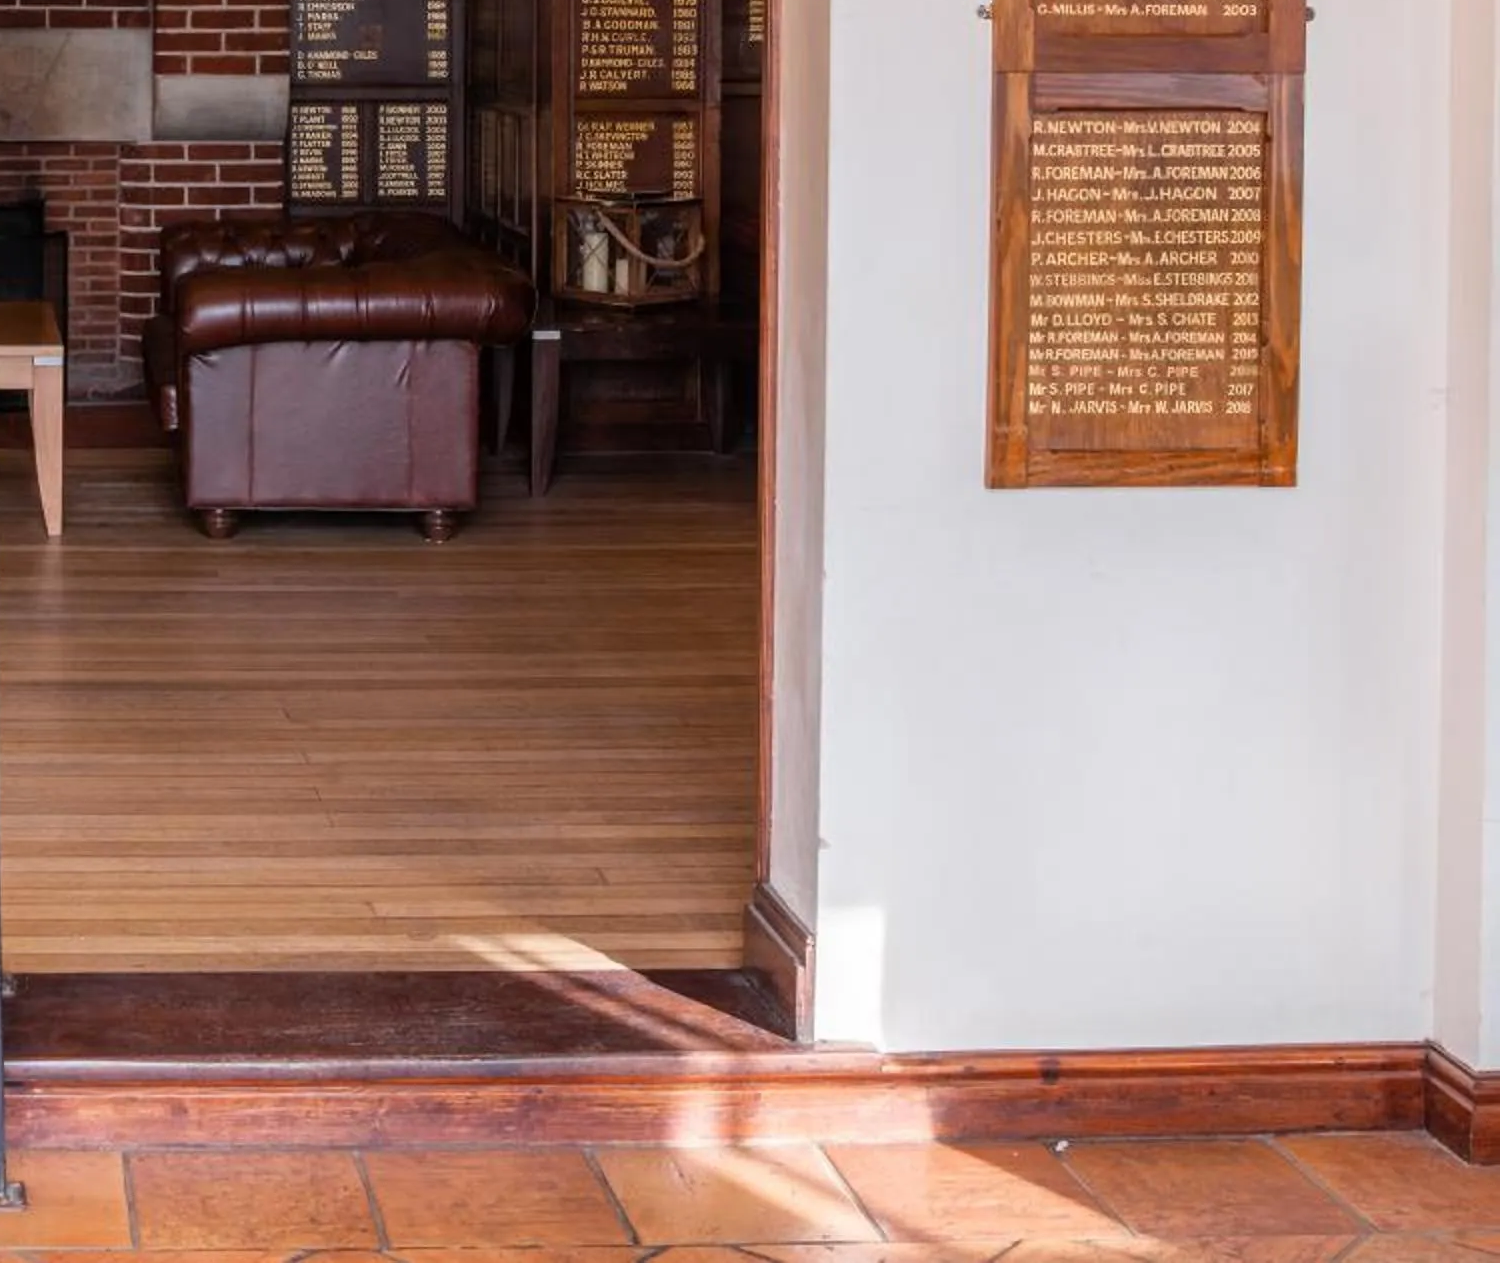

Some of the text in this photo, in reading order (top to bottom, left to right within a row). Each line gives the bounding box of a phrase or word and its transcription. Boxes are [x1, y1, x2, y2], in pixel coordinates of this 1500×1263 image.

[1223, 4, 1258, 16] 2003
[1227, 122, 1260, 133] 2004
[1227, 144, 1261, 157] 2005
[1229, 166, 1261, 179] 2006
[1229, 187, 1261, 199] 2007
[1231, 209, 1261, 222] 2008
[1230, 231, 1261, 243] 2009
[1129, 314, 1153, 326] Mrs
[1172, 313, 1216, 326] CHATE
[1070, 366, 1100, 377] PIPE
[1118, 367, 1142, 377] Mrs
[1167, 366, 1199, 378] PIPE
[1065, 383, 1094, 395] PIPE
[1155, 383, 1186, 396] PIPE
[1228, 385, 1253, 396] 2017
[1172, 401, 1213, 413] JARVIS
